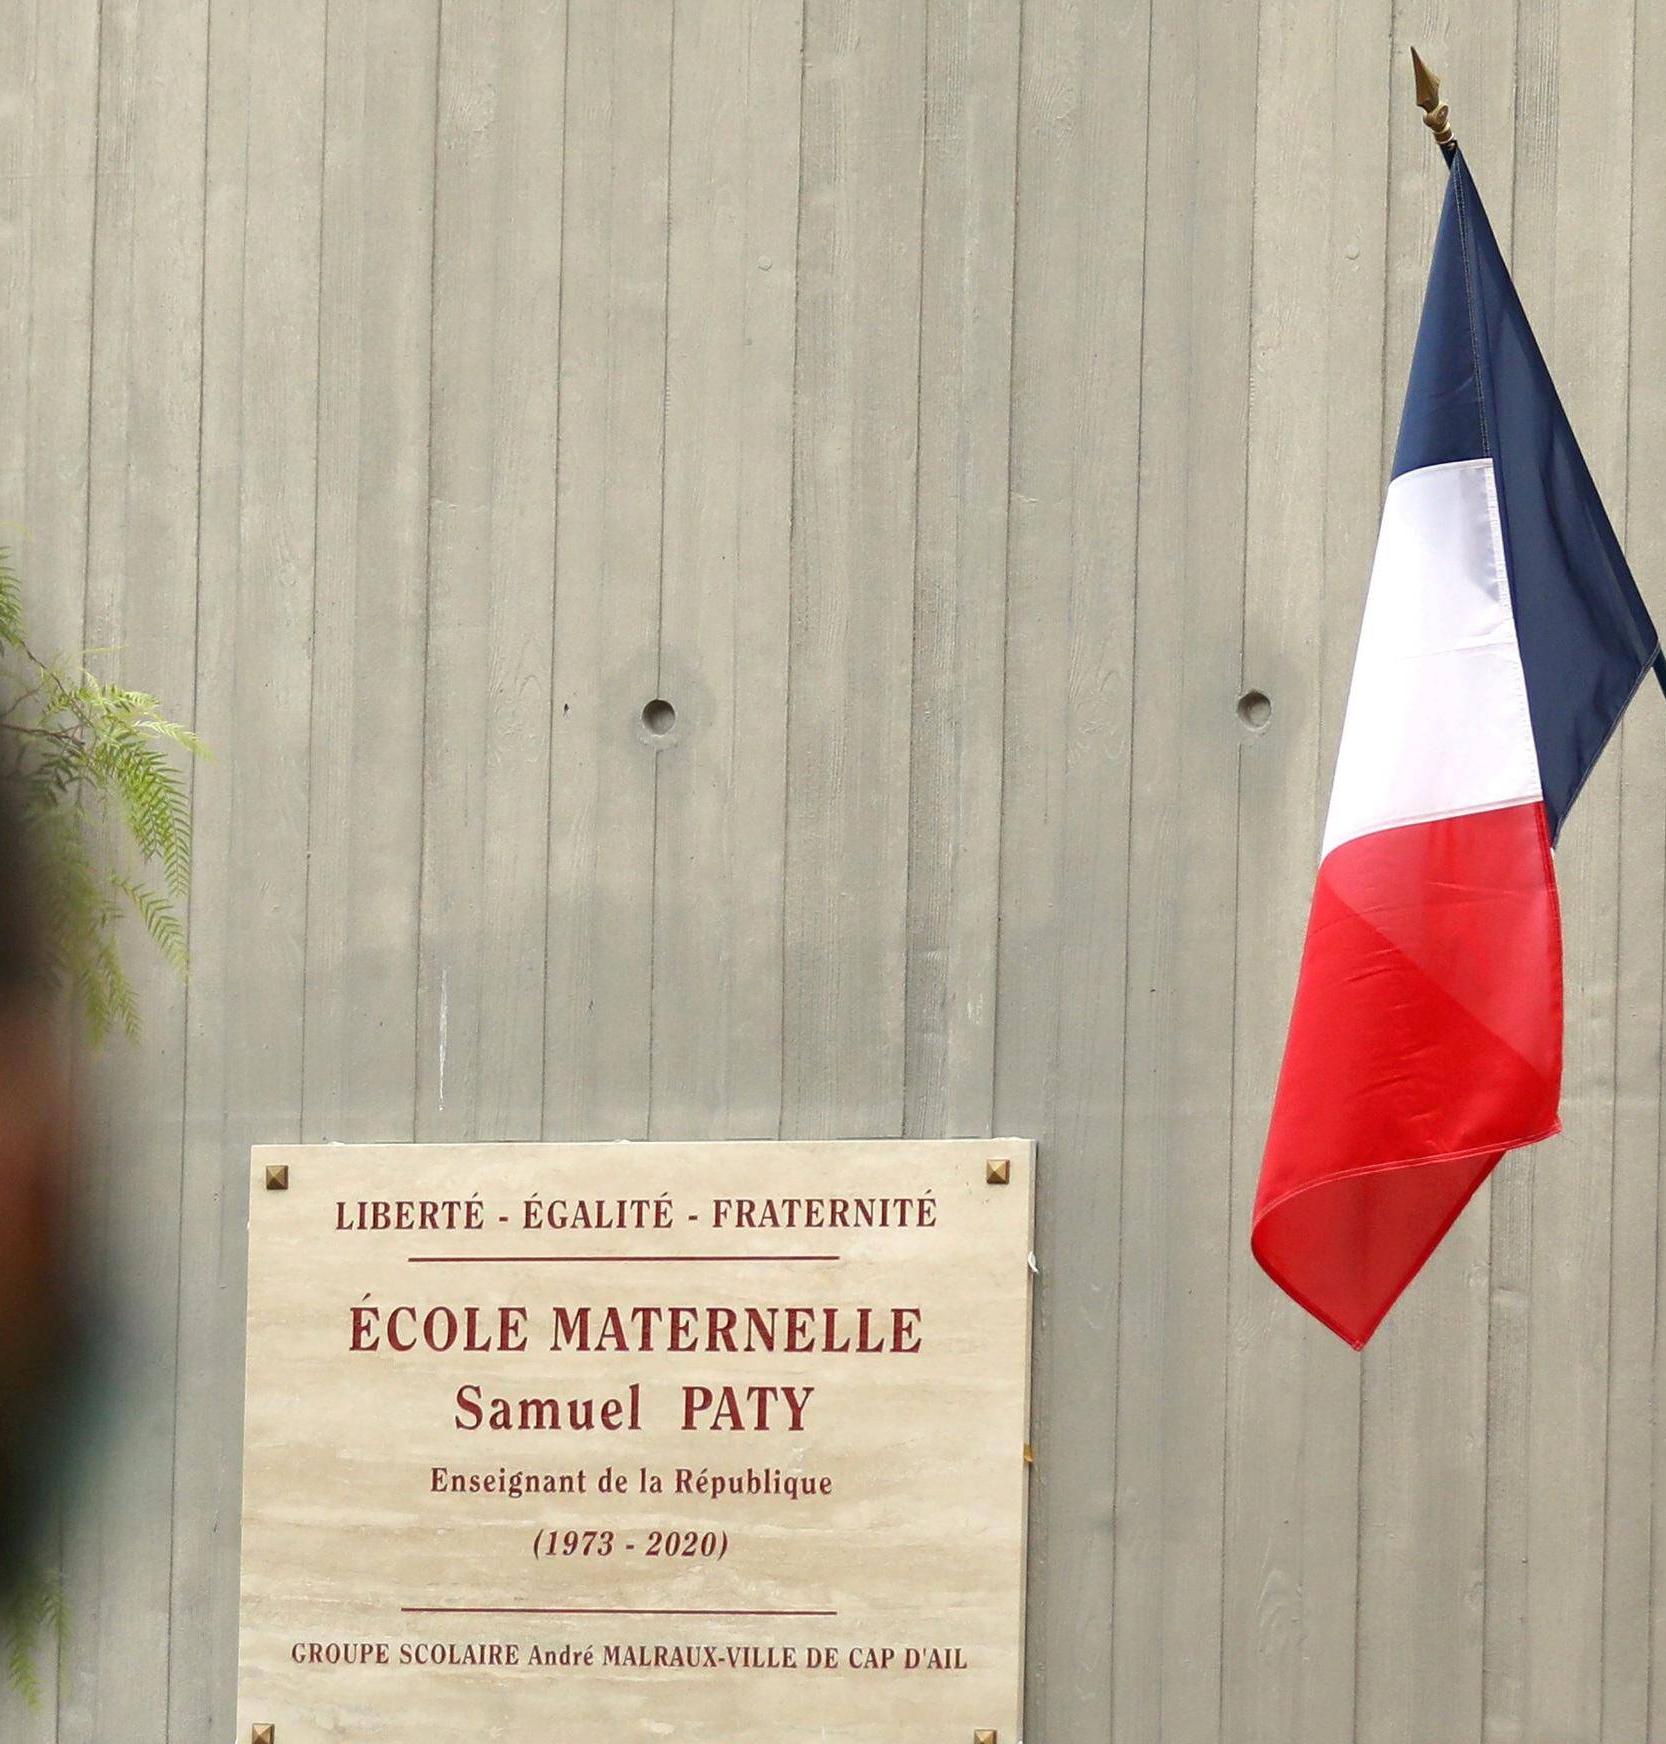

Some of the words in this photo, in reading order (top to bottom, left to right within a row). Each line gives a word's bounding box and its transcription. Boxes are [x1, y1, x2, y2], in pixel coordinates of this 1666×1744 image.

[336, 1192, 484, 1230] LIBERTÉ
[523, 1192, 673, 1229] ÉGALITÉ
[713, 1189, 936, 1228] FRATERNITÉ
[349, 1293, 527, 1352] ÉCOLE
[550, 1307, 922, 1353] MATERNELLE
[455, 1383, 641, 1431] Samuel
[681, 1386, 815, 1431] PATY
[431, 1467, 586, 1498] Enseignant
[598, 1467, 627, 1493] de
[640, 1467, 662, 1494] la
[675, 1468, 832, 1500] République
[534, 1529, 614, 1560] (1973
[645, 1531, 728, 1561] 2020)
[292, 1643, 389, 1664] GROUPE
[400, 1644, 519, 1665] SCOLAIRE
[528, 1644, 593, 1666] André
[603, 1646, 797, 1669] MALRAUX-VILLE
[807, 1648, 838, 1669] DE
[849, 1648, 894, 1669] CAP
[904, 1648, 967, 1669] D'AIL
